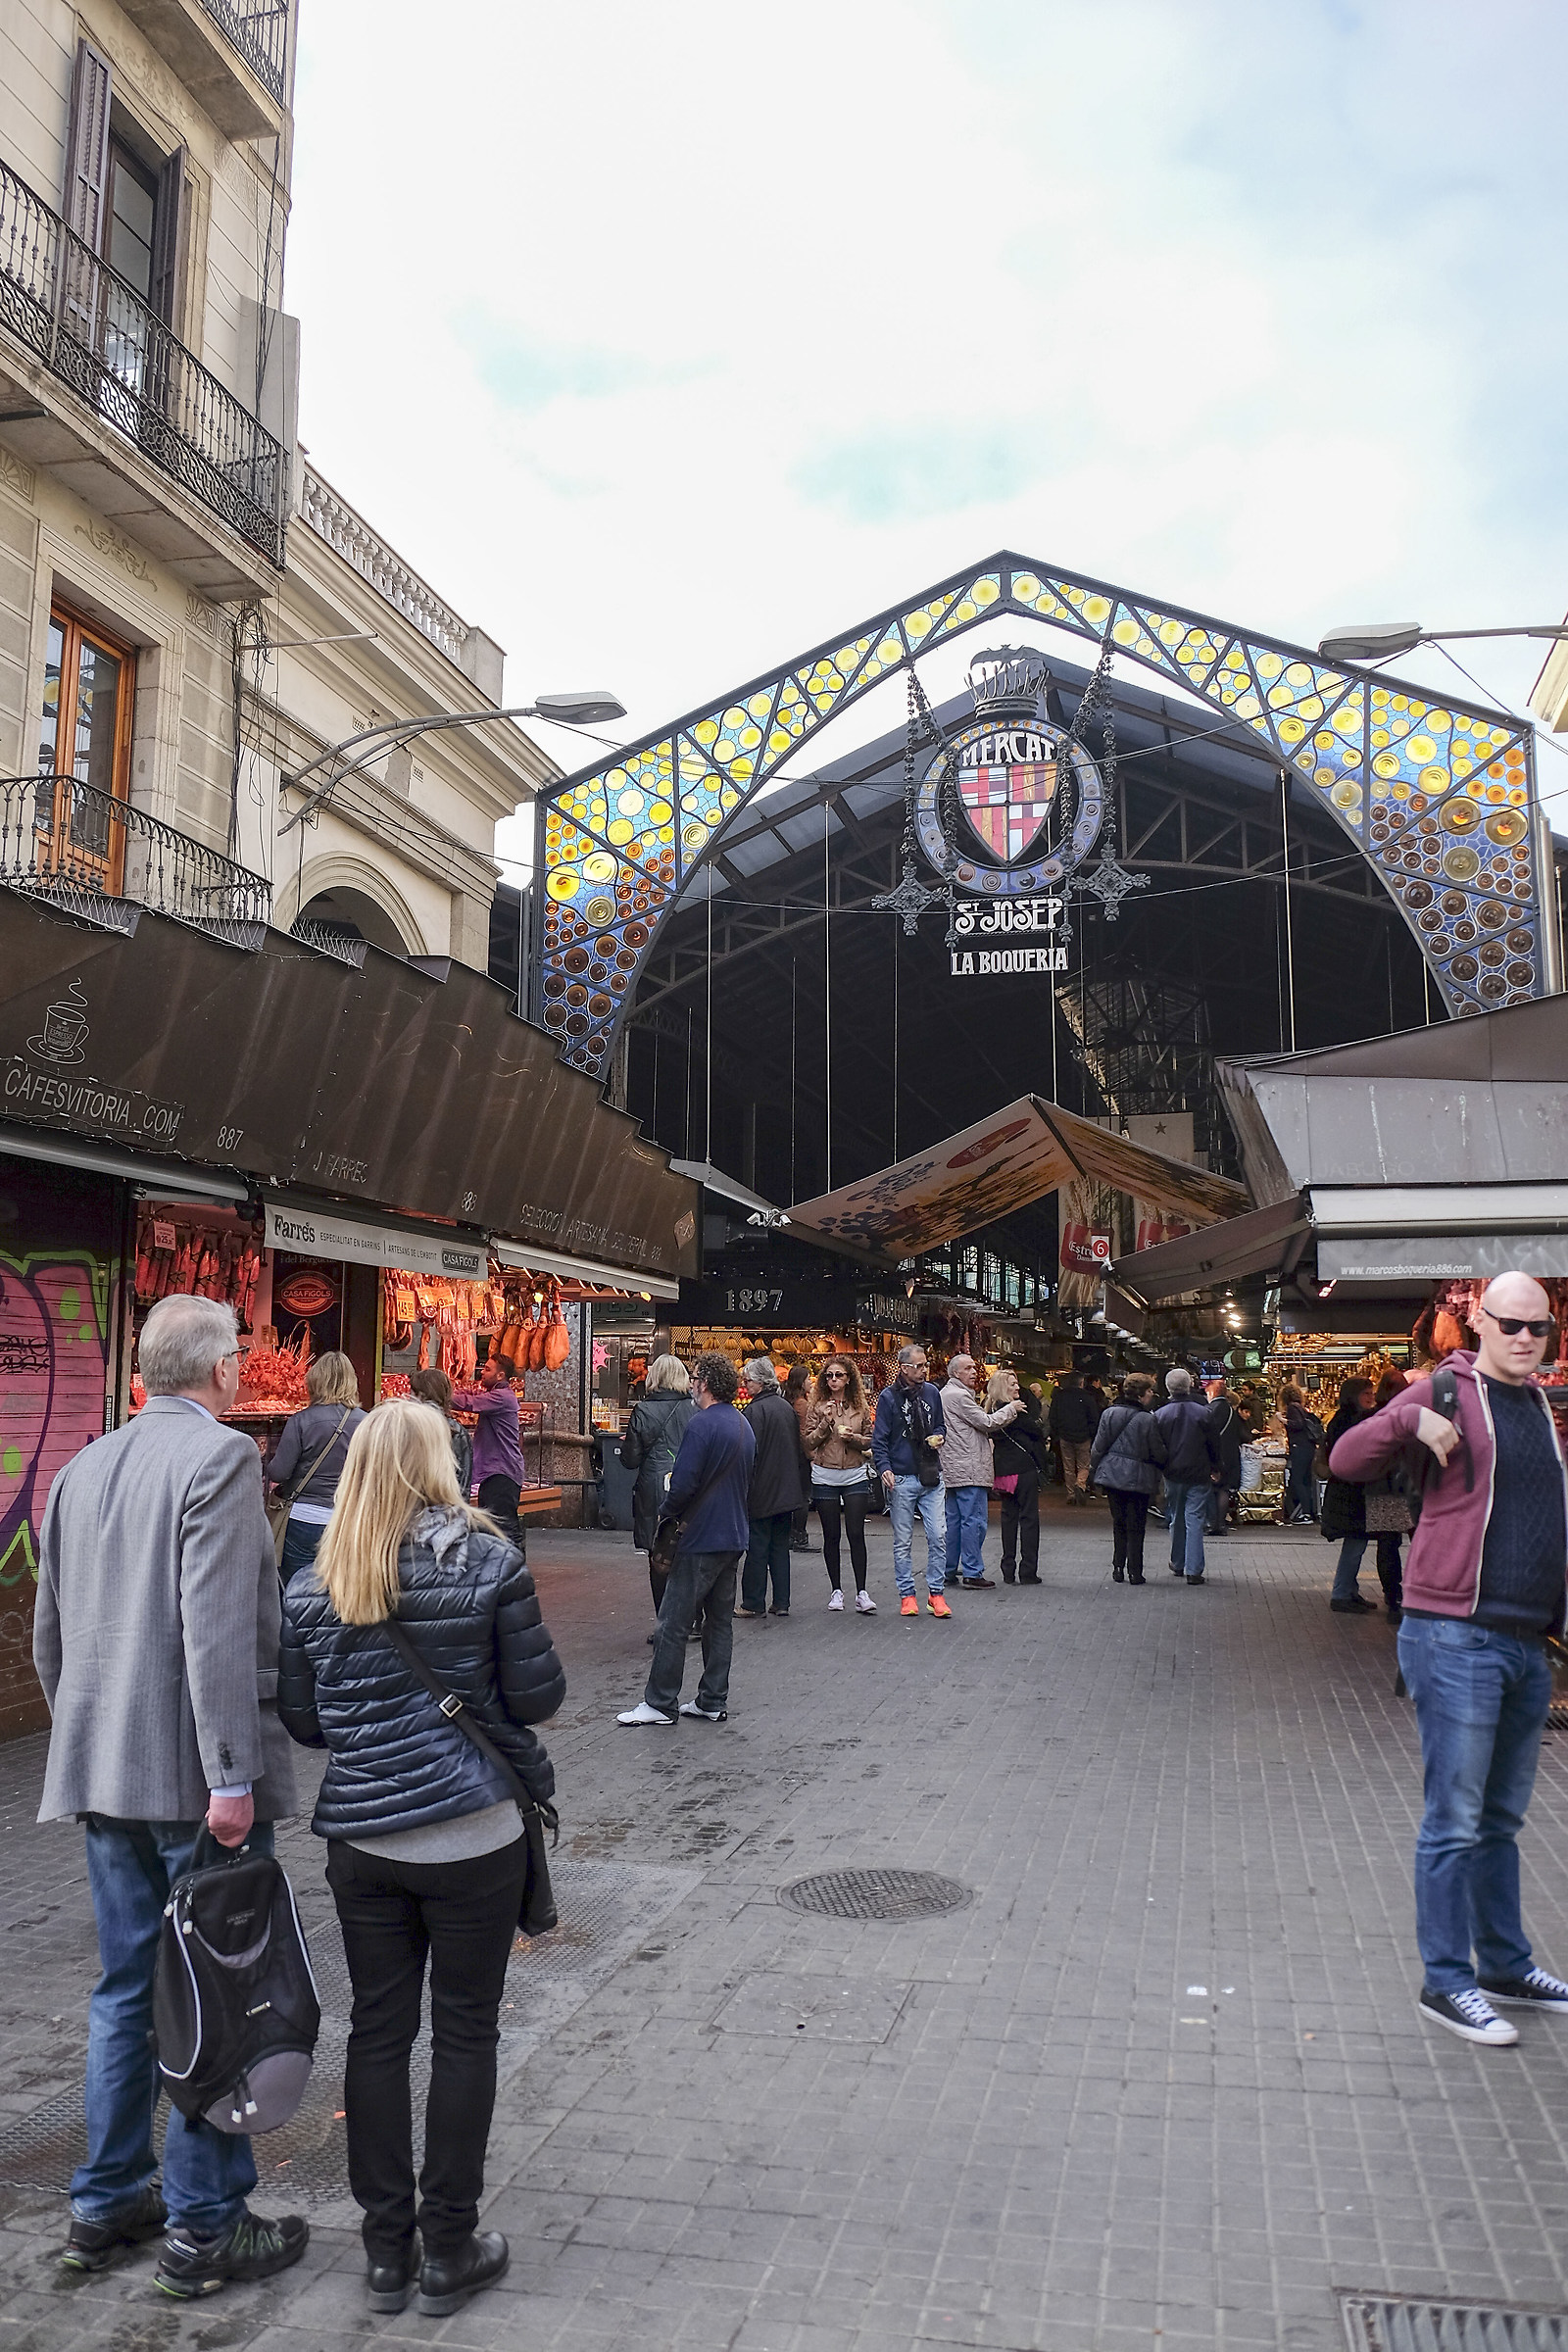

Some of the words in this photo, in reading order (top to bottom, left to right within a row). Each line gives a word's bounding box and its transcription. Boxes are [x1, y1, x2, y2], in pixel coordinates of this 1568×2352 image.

[962, 731, 1054, 766] MERCAT
[980, 899, 1063, 932] JOSEP
[952, 953, 974, 975] LA
[979, 948, 1068, 974] BOQUERIA
[217, 1126, 244, 1151] 887
[314, 1152, 322, 1171] J
[462, 1192, 477, 1211] 888
[274, 1214, 315, 1243] Farrés
[353, 1239, 361, 1248] EN
[443, 1253, 460, 1265] CASA
[1097, 1243, 1104, 1254] 6
[1341, 1263, 1473, 1277] www.marcosboqueria886.com
[725, 1289, 783, 1311] 1897
